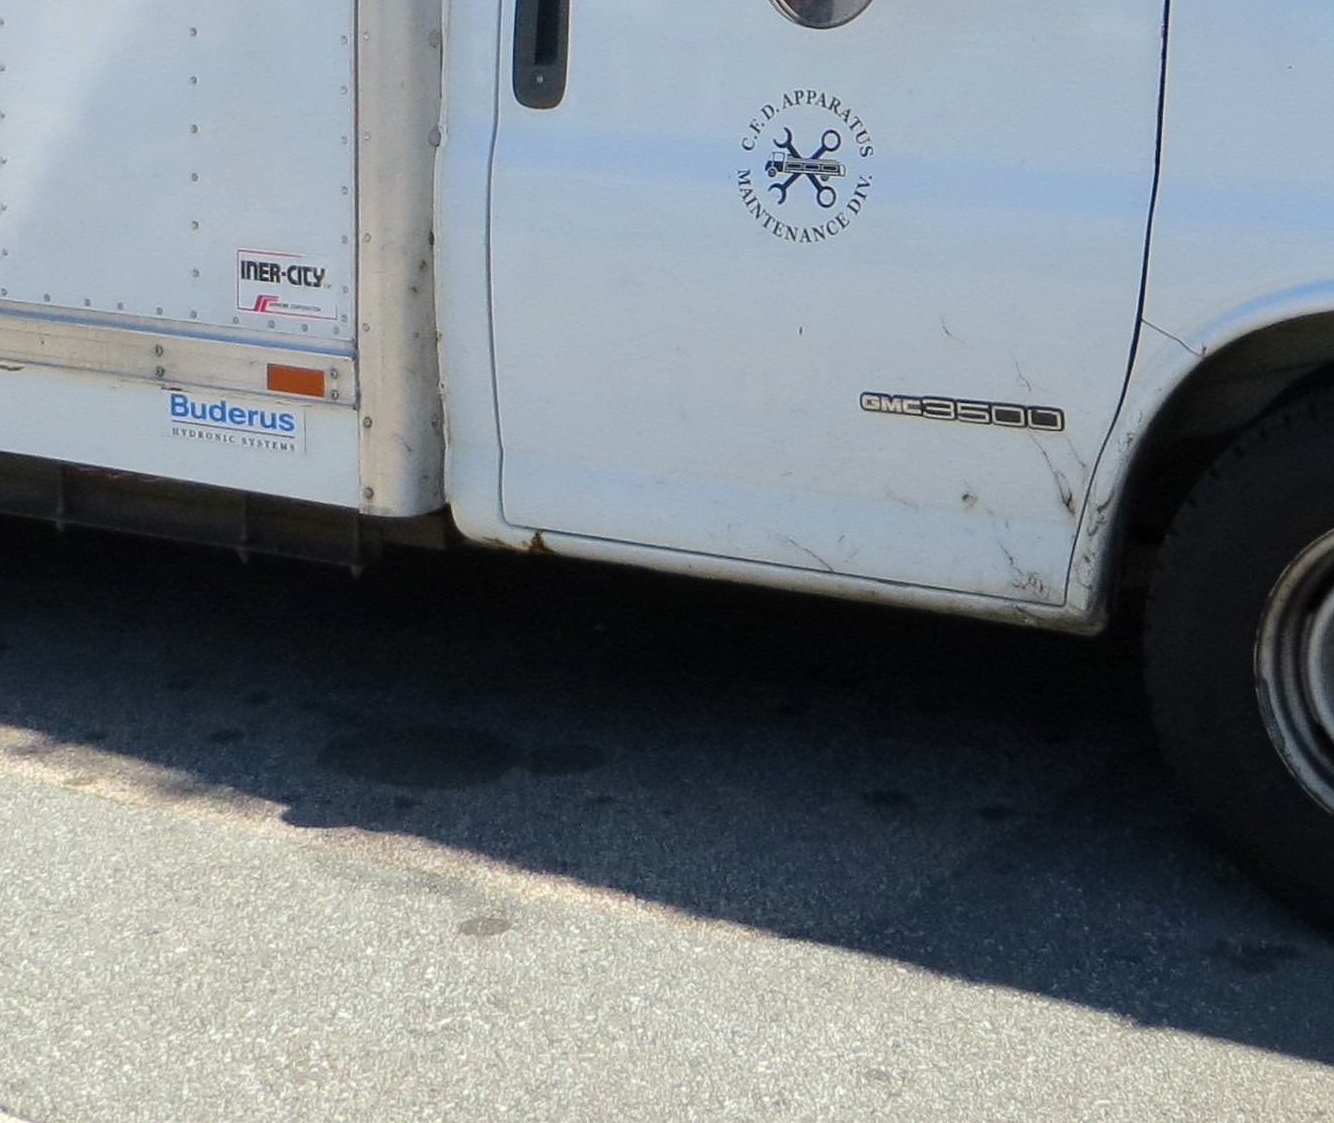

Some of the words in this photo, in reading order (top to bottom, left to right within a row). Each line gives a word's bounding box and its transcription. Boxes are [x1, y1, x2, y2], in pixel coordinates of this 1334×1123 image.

[781, 89, 875, 159] APPARATUS
[737, 168, 851, 244] MAINTENANCE
[846, 174, 874, 216] DIV.
[240, 259, 326, 288] INER-CITY
[170, 393, 296, 432] Buderus
[172, 427, 236, 444] HYDRONIC
[241, 436, 296, 453] SYSTEMS
